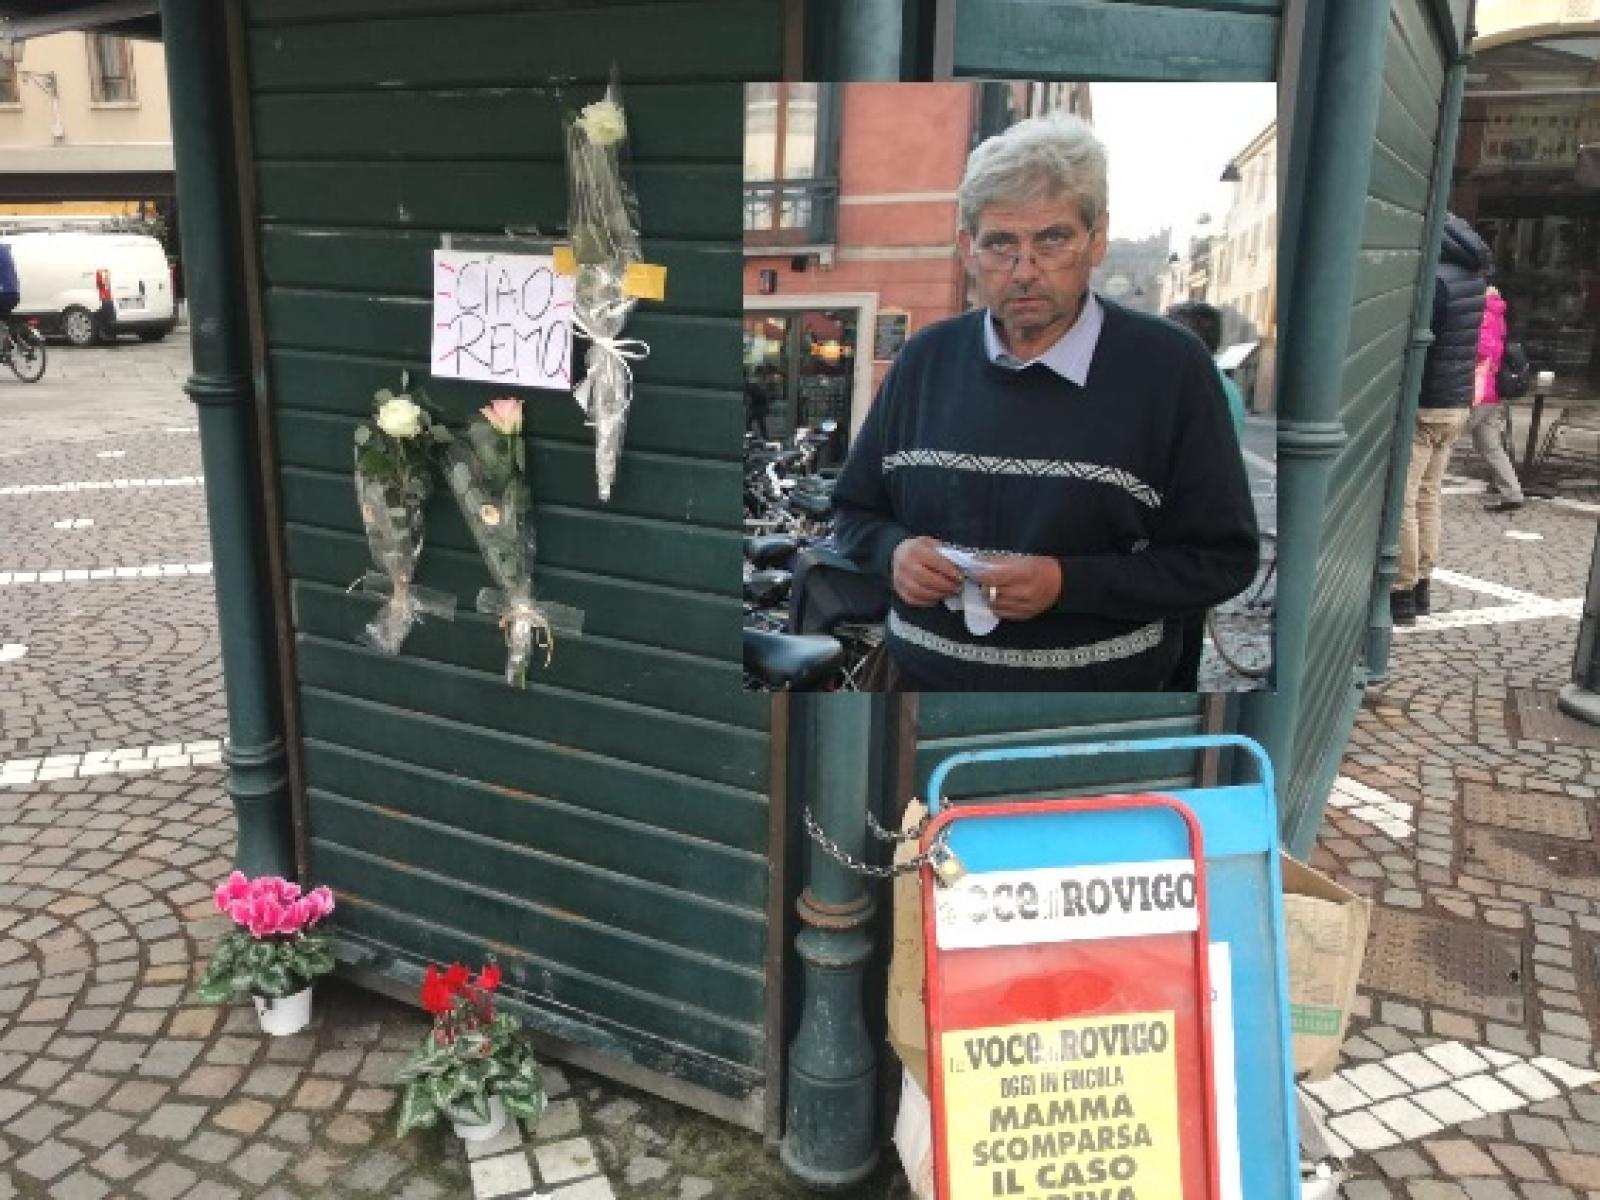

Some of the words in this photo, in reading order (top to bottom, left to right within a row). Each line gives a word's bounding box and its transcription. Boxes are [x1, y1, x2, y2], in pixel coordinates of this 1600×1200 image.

[457, 256, 554, 320] CIAO
[449, 311, 570, 378] REMO
[1060, 872, 1197, 917] ROVIGO
[1060, 1021, 1168, 1062] ROVIGO
[1001, 1075, 1036, 1098] OGGI
[1041, 1072, 1058, 1092] IN
[990, 1092, 1135, 1132] MAMMA
[973, 1123, 1152, 1166] SCOMPARSA
[993, 1169, 1024, 1197] IL
[1036, 1154, 1137, 1189] CASO
